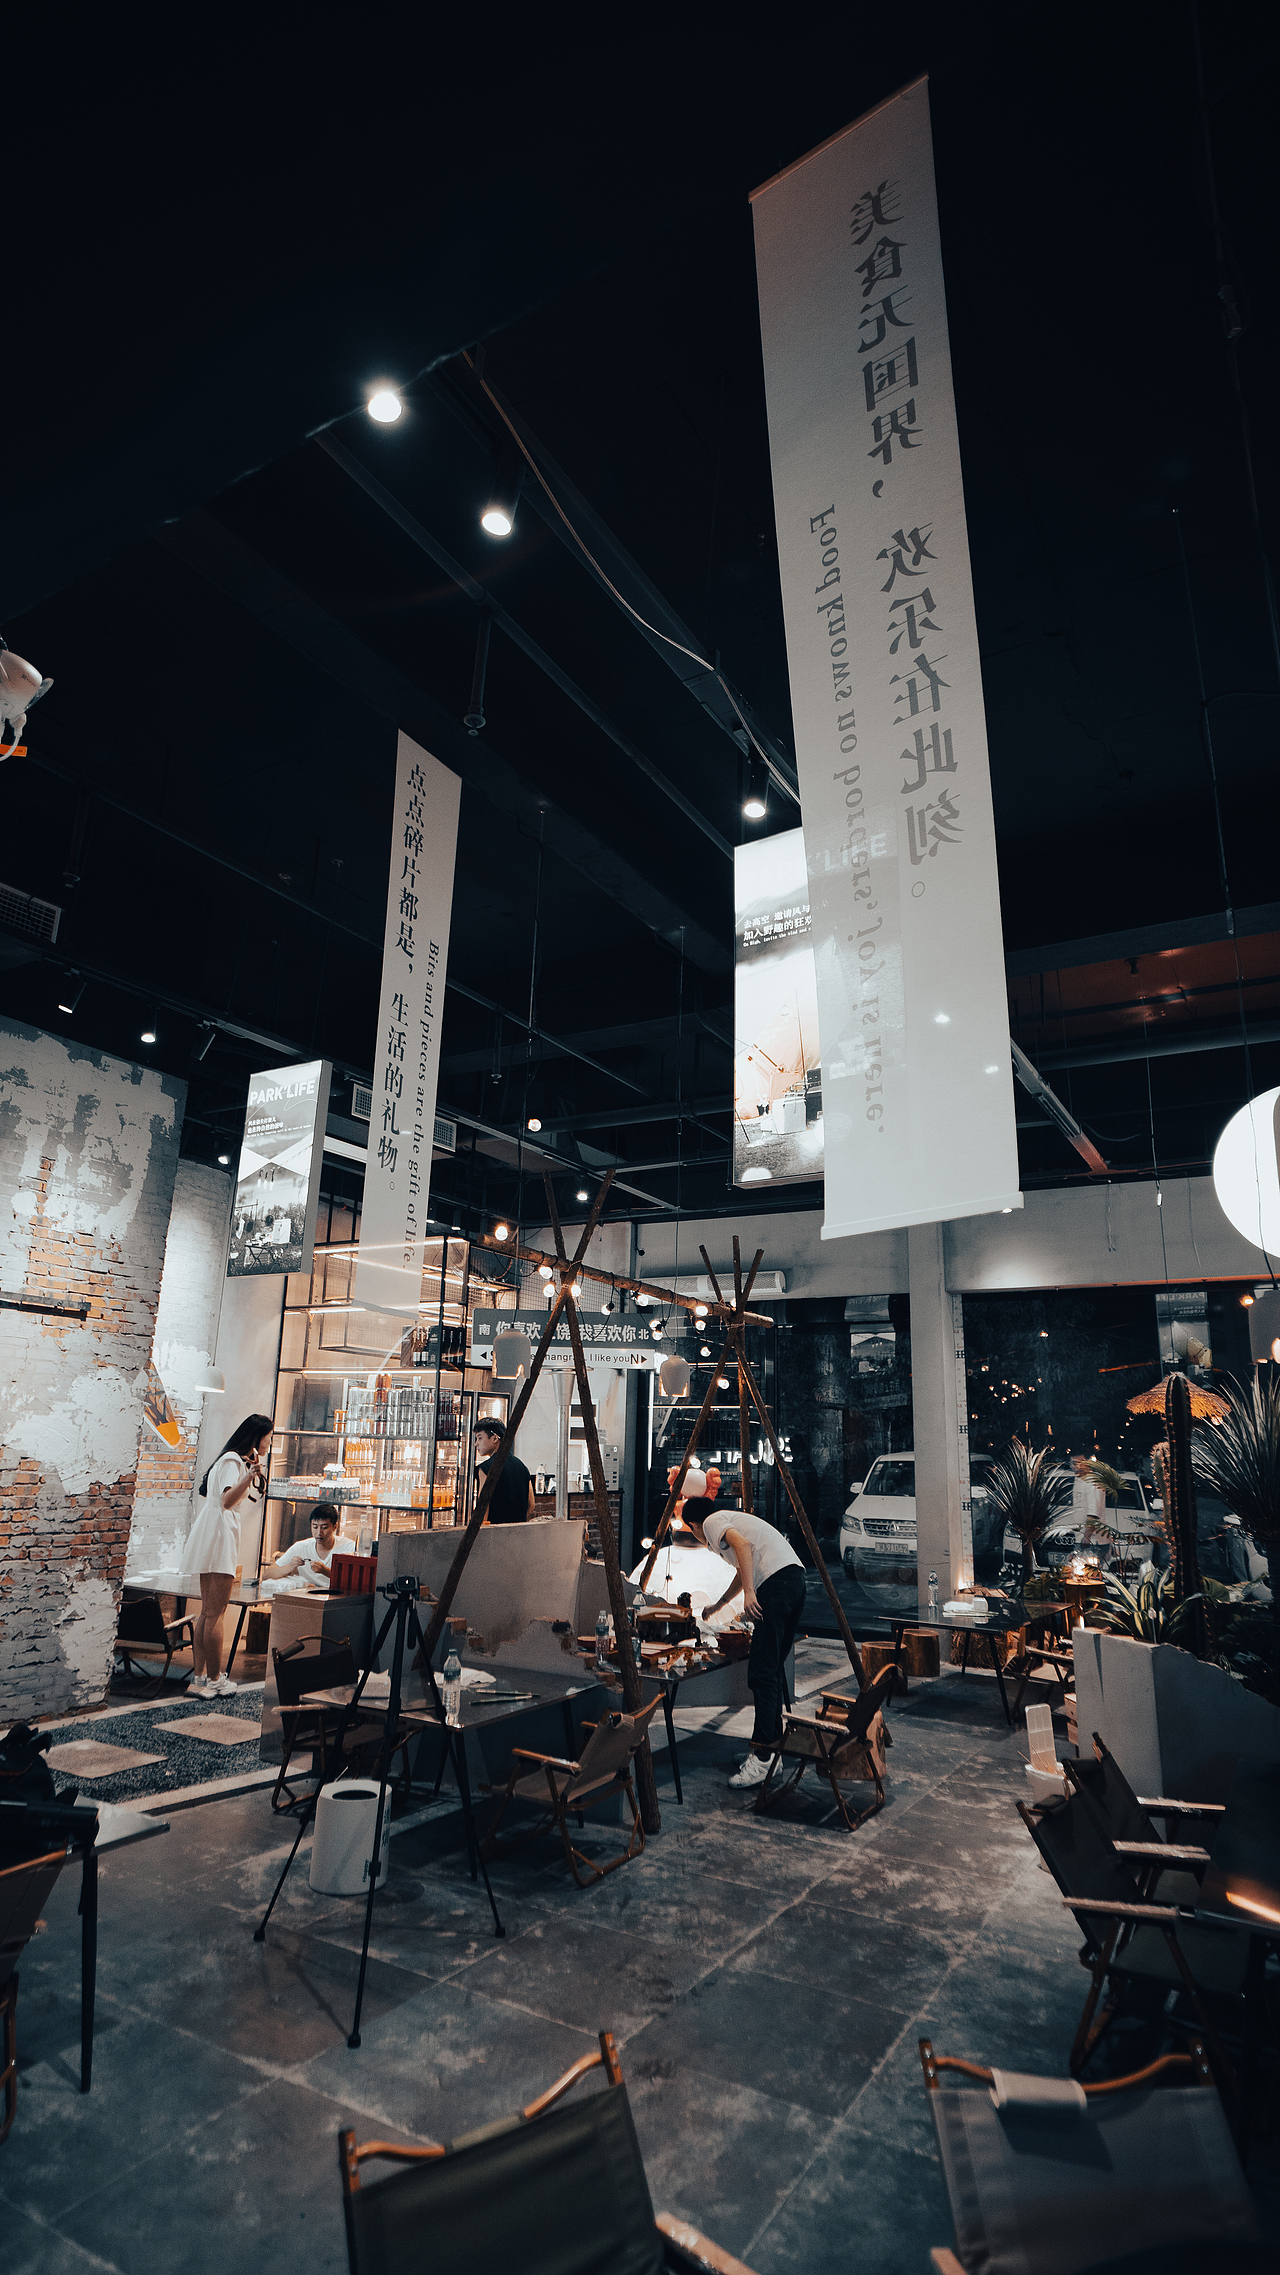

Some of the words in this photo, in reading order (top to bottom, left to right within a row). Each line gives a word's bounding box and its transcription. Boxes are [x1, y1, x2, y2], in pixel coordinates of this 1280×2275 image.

[427, 940, 440, 977] Bits
[424, 982, 435, 1018] and
[418, 1019, 432, 1081] pieces
[249, 1080, 316, 1106] PARK'LIFE
[415, 1087, 425, 1116] are
[411, 1123, 424, 1154] the
[407, 1159, 420, 1196] gift
[407, 1202, 418, 1229] of
[479, 1323, 491, 1336] 南
[638, 1328, 650, 1340] 北
[595, 1353, 611, 1361] like
[613, 1355, 629, 1365] you
[630, 1353, 639, 1364] N
